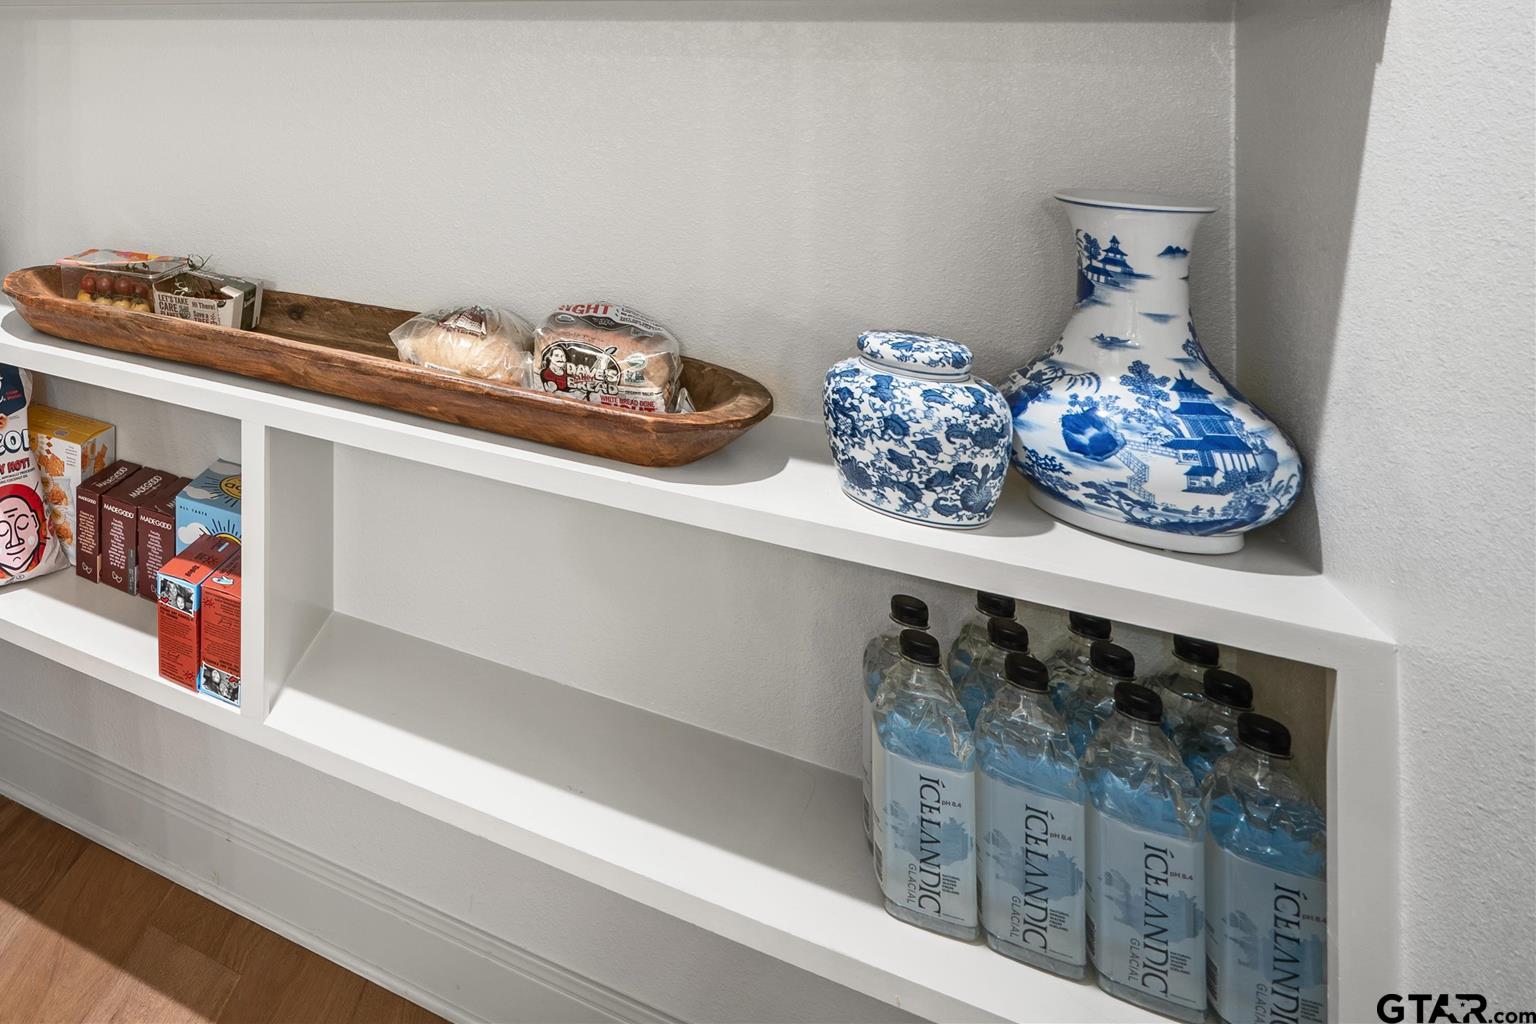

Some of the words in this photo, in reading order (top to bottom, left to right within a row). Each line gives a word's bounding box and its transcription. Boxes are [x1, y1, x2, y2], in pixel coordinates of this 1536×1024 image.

[566, 362, 618, 383] DAVE'S
[567, 377, 619, 395] BREAD
[6, 457, 31, 473] HOT!
[96, 466, 128, 488] MADEGOOD
[128, 475, 163, 498] MADEGOOD
[77, 494, 97, 505] MADEGOOD
[103, 503, 135, 520] MADEGOOD
[139, 514, 172, 530] MADEGOOD
[906, 863, 917, 905] GLACIAL
[1009, 895, 1021, 939] GLACIAL
[1128, 938, 1140, 983] GLACIAL
